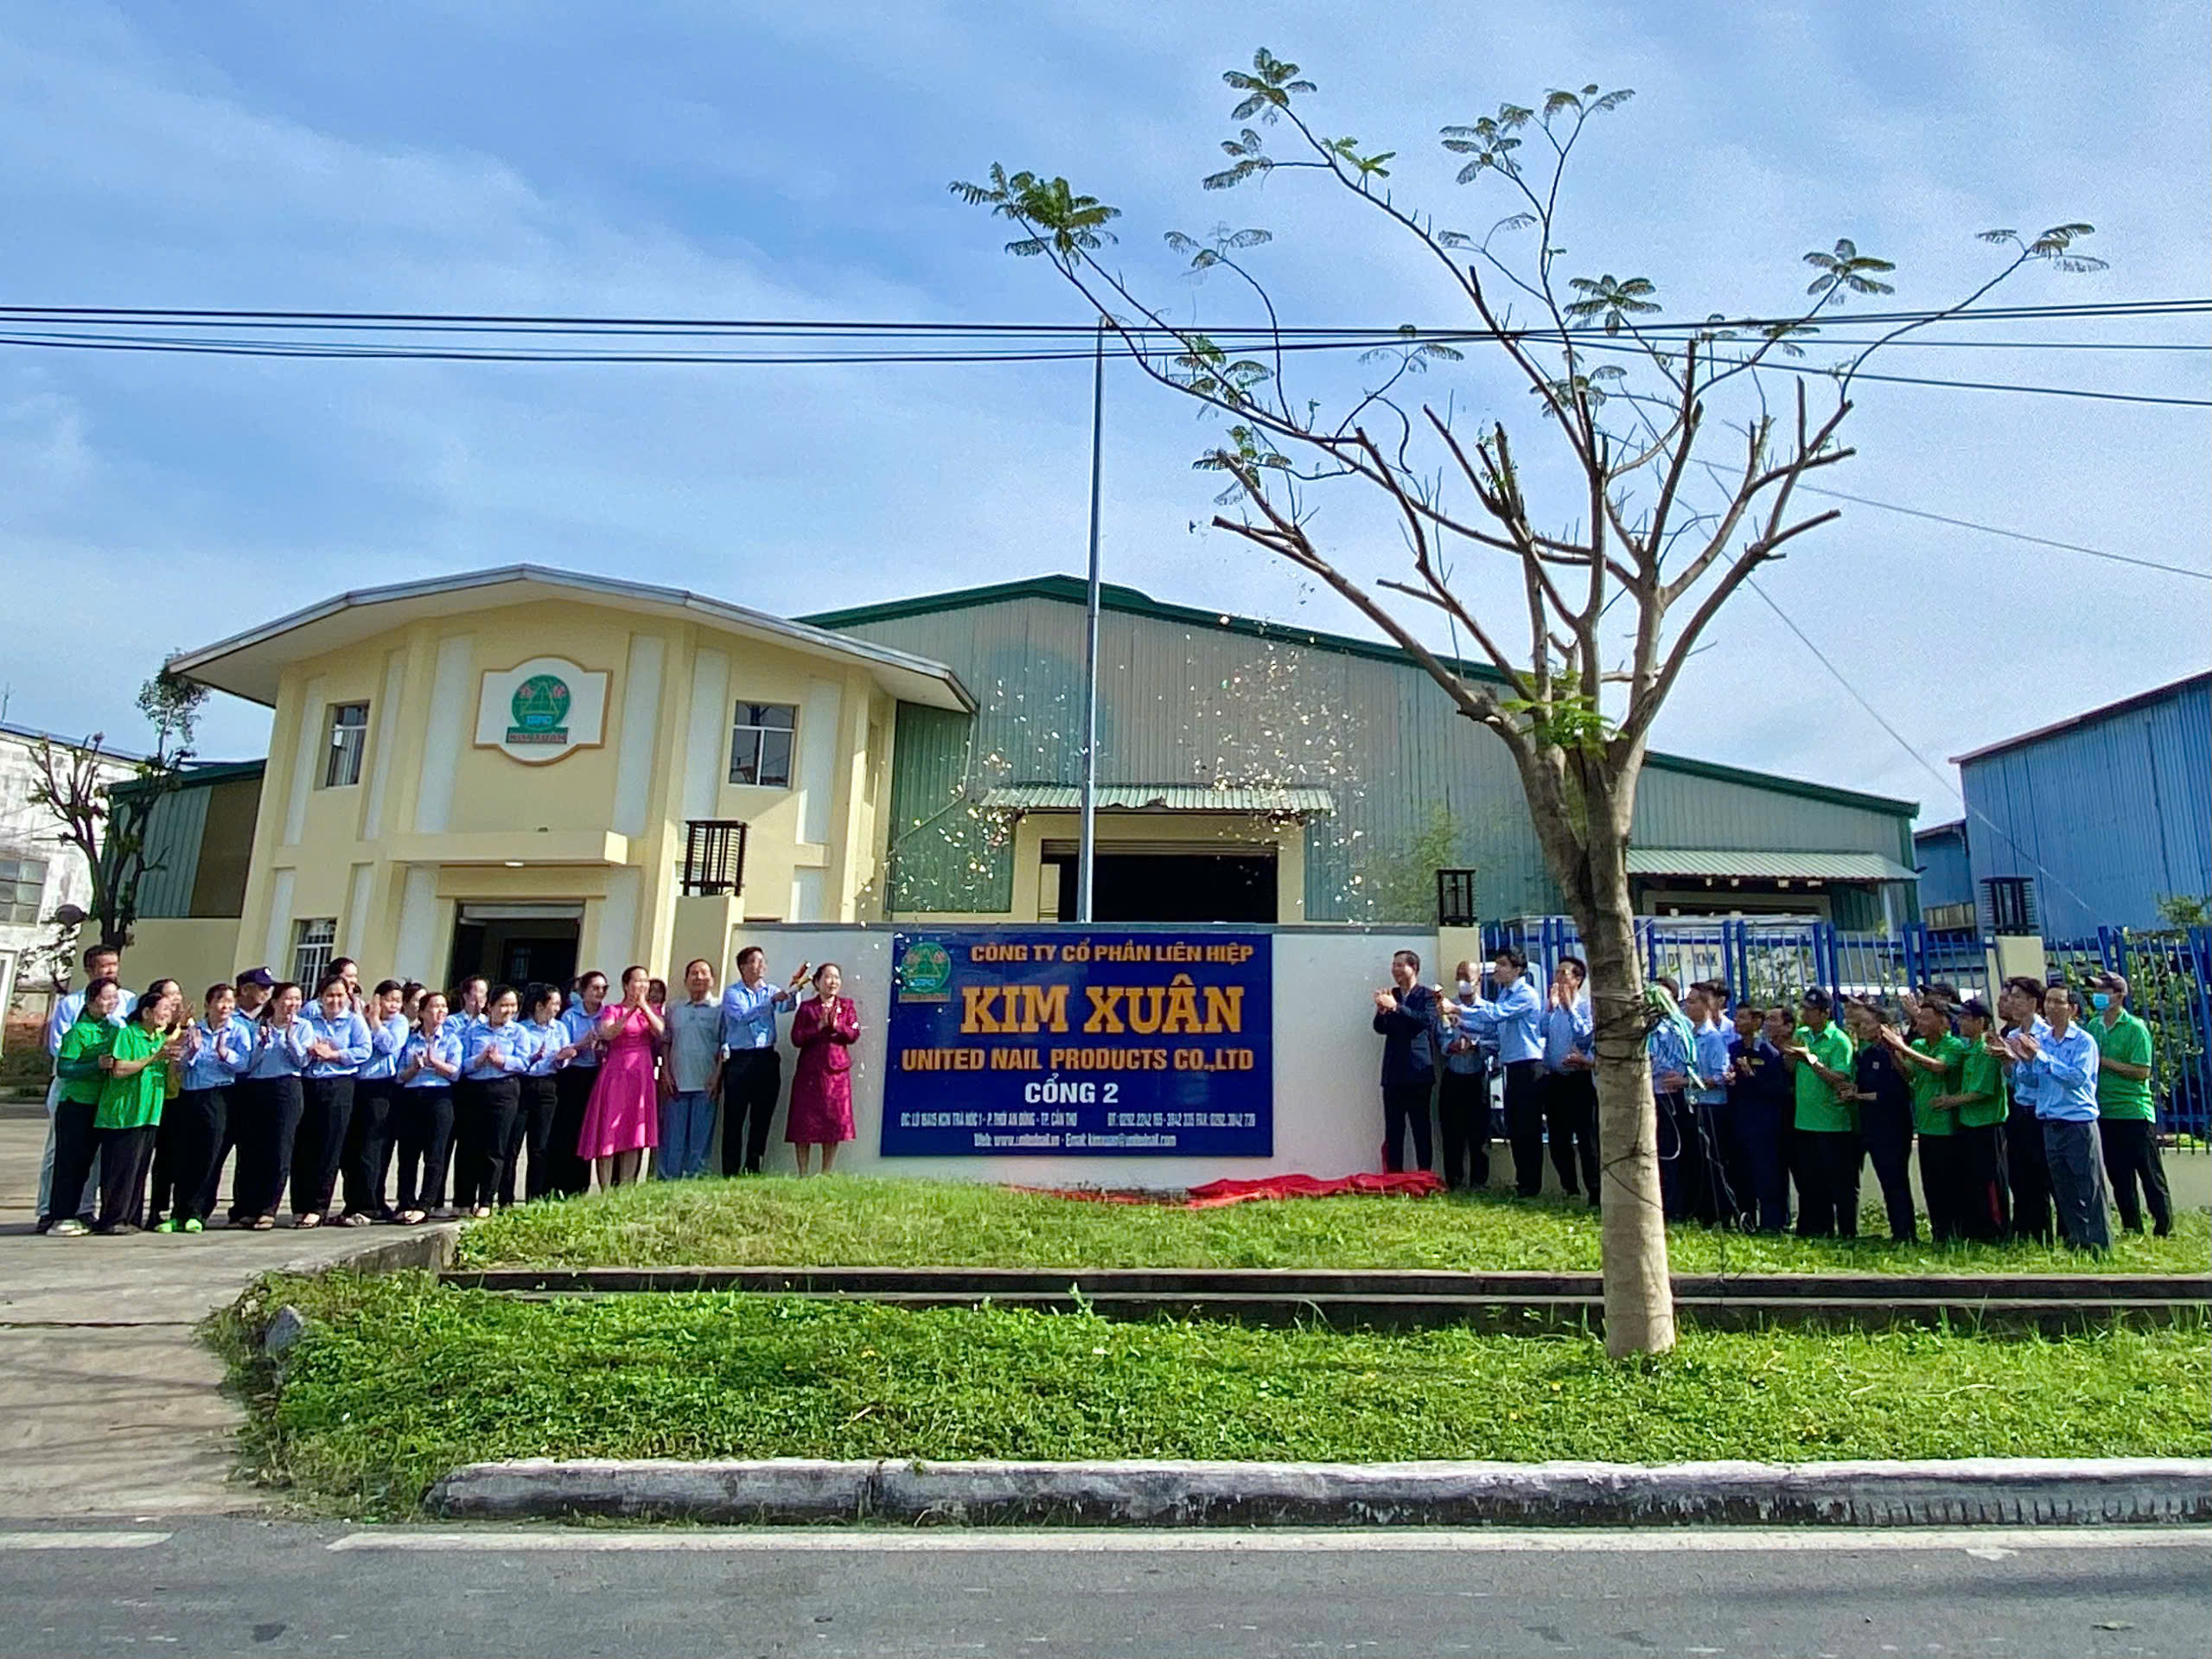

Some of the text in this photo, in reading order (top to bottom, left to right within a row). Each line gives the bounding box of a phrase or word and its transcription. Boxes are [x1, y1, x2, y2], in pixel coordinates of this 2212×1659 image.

[971, 941, 1028, 962] CÔNG
[1033, 945, 1057, 961] TY
[1061, 936, 1091, 961] CỔ
[1155, 941, 1202, 962] LIÊN
[1206, 941, 1255, 967] HIỆP
[959, 972, 1245, 1035] KIM XUÂN
[902, 1049, 1255, 1071] UNITED NAIL PRODUCTS CO.,LTD
[1024, 1073, 1119, 1104] CỔNG 2
